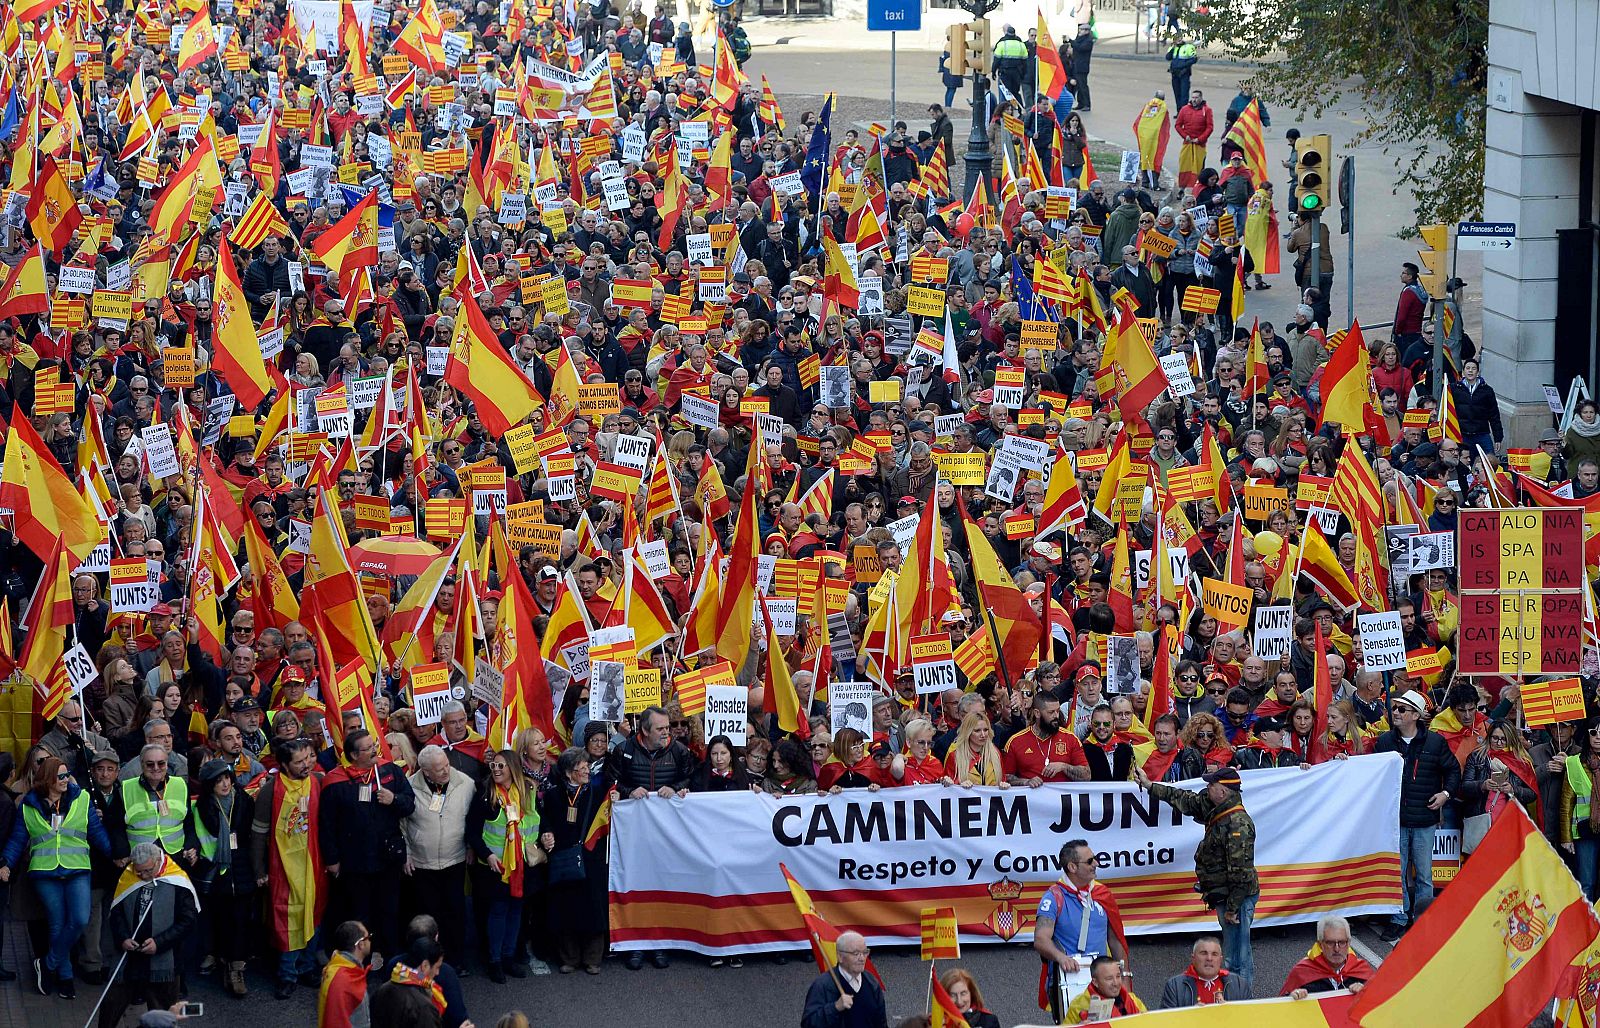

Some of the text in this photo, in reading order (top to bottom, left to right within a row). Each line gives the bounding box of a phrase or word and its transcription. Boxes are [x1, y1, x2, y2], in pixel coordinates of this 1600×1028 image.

[884, 10, 904, 20] taxi
[605, 183, 625, 193] Sensatez
[502, 197, 524, 208] Sensatez
[689, 239, 710, 250] Sensatez
[1144, 236, 1173, 253] JUNTOS
[701, 286, 724, 298] JUNTOS
[164, 352, 191, 361] Minoria
[165, 364, 191, 374] golpista,
[578, 387, 618, 398] SOM CATALUNYA
[996, 387, 1022, 404] JUNTS
[597, 398, 619, 409] ESPAÑA
[322, 418, 349, 433] JUNTS
[760, 416, 781, 432] UNTS
[619, 437, 648, 457] JUNTS
[940, 456, 952, 465] Amb
[953, 458, 965, 468] pau
[969, 457, 984, 467] seny,
[939, 468, 950, 478] tots
[550, 478, 573, 496] JUNTS
[528, 528, 561, 541] CATALUNYA
[1471, 544, 1484, 558] IS
[360, 561, 387, 570] ESPAÑA
[855, 556, 879, 572] JUNTOS
[114, 586, 147, 607] JUNTS
[1204, 589, 1249, 615] JUNTOS
[1476, 600, 1494, 615] ES
[1258, 610, 1290, 630] JUNTS
[1360, 620, 1400, 634] Cordura,
[915, 646, 924, 654] DE
[1363, 637, 1402, 651] Sensatez,
[1366, 652, 1405, 667] SENY!
[1475, 651, 1493, 666] ES
[917, 667, 953, 687] JUNTS
[707, 695, 746, 714] Sensatez
[1554, 693, 1582, 706] DE TODOS
[707, 718, 746, 738] y paz.
[772, 792, 1183, 847] CAMINEM JUNT
[838, 842, 1175, 885] Respeto y Convencia
[1041, 899, 1051, 912] 3
